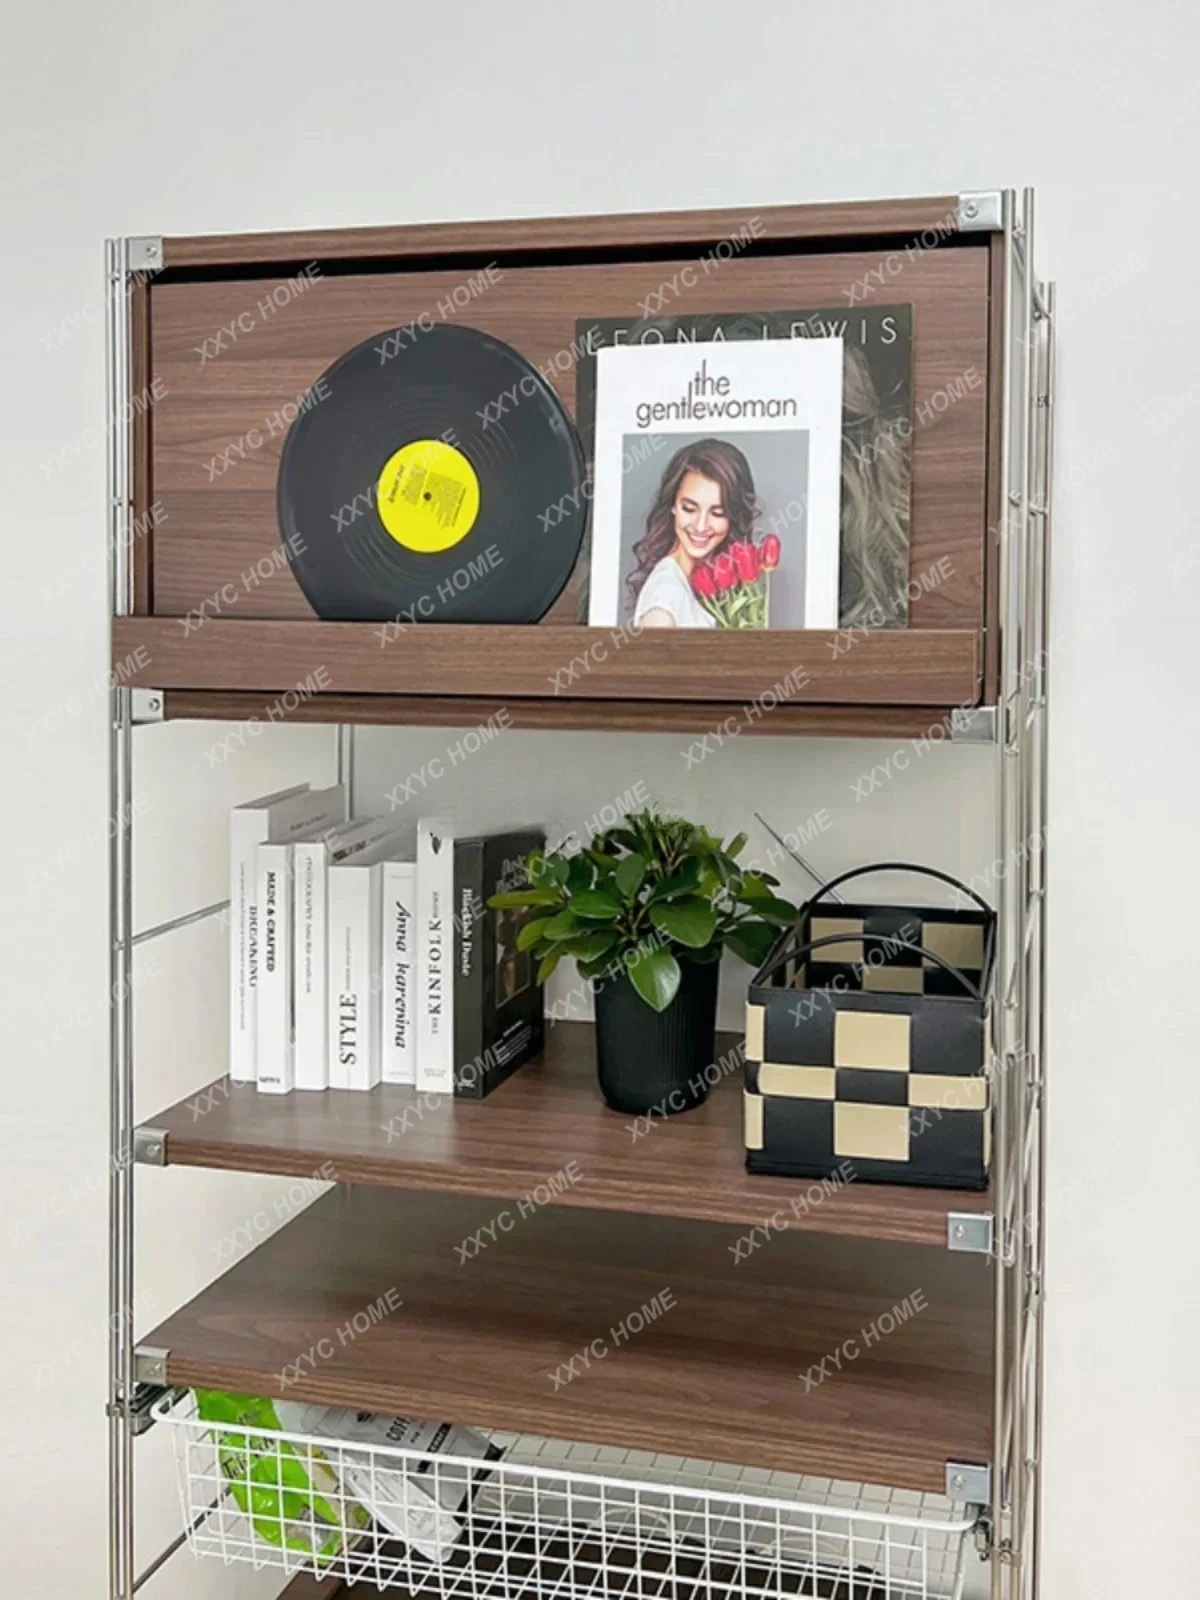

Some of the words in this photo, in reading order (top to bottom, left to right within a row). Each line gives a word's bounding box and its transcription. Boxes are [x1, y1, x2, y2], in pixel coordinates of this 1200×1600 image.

[636, 380, 797, 428] gentlewoman
[693, 359, 730, 397] the
[396, 901, 412, 952] Anna
[428, 919, 441, 1014] KINFOLK
[340, 994, 357, 1065] STYLE
[395, 963, 410, 1048] karenina
